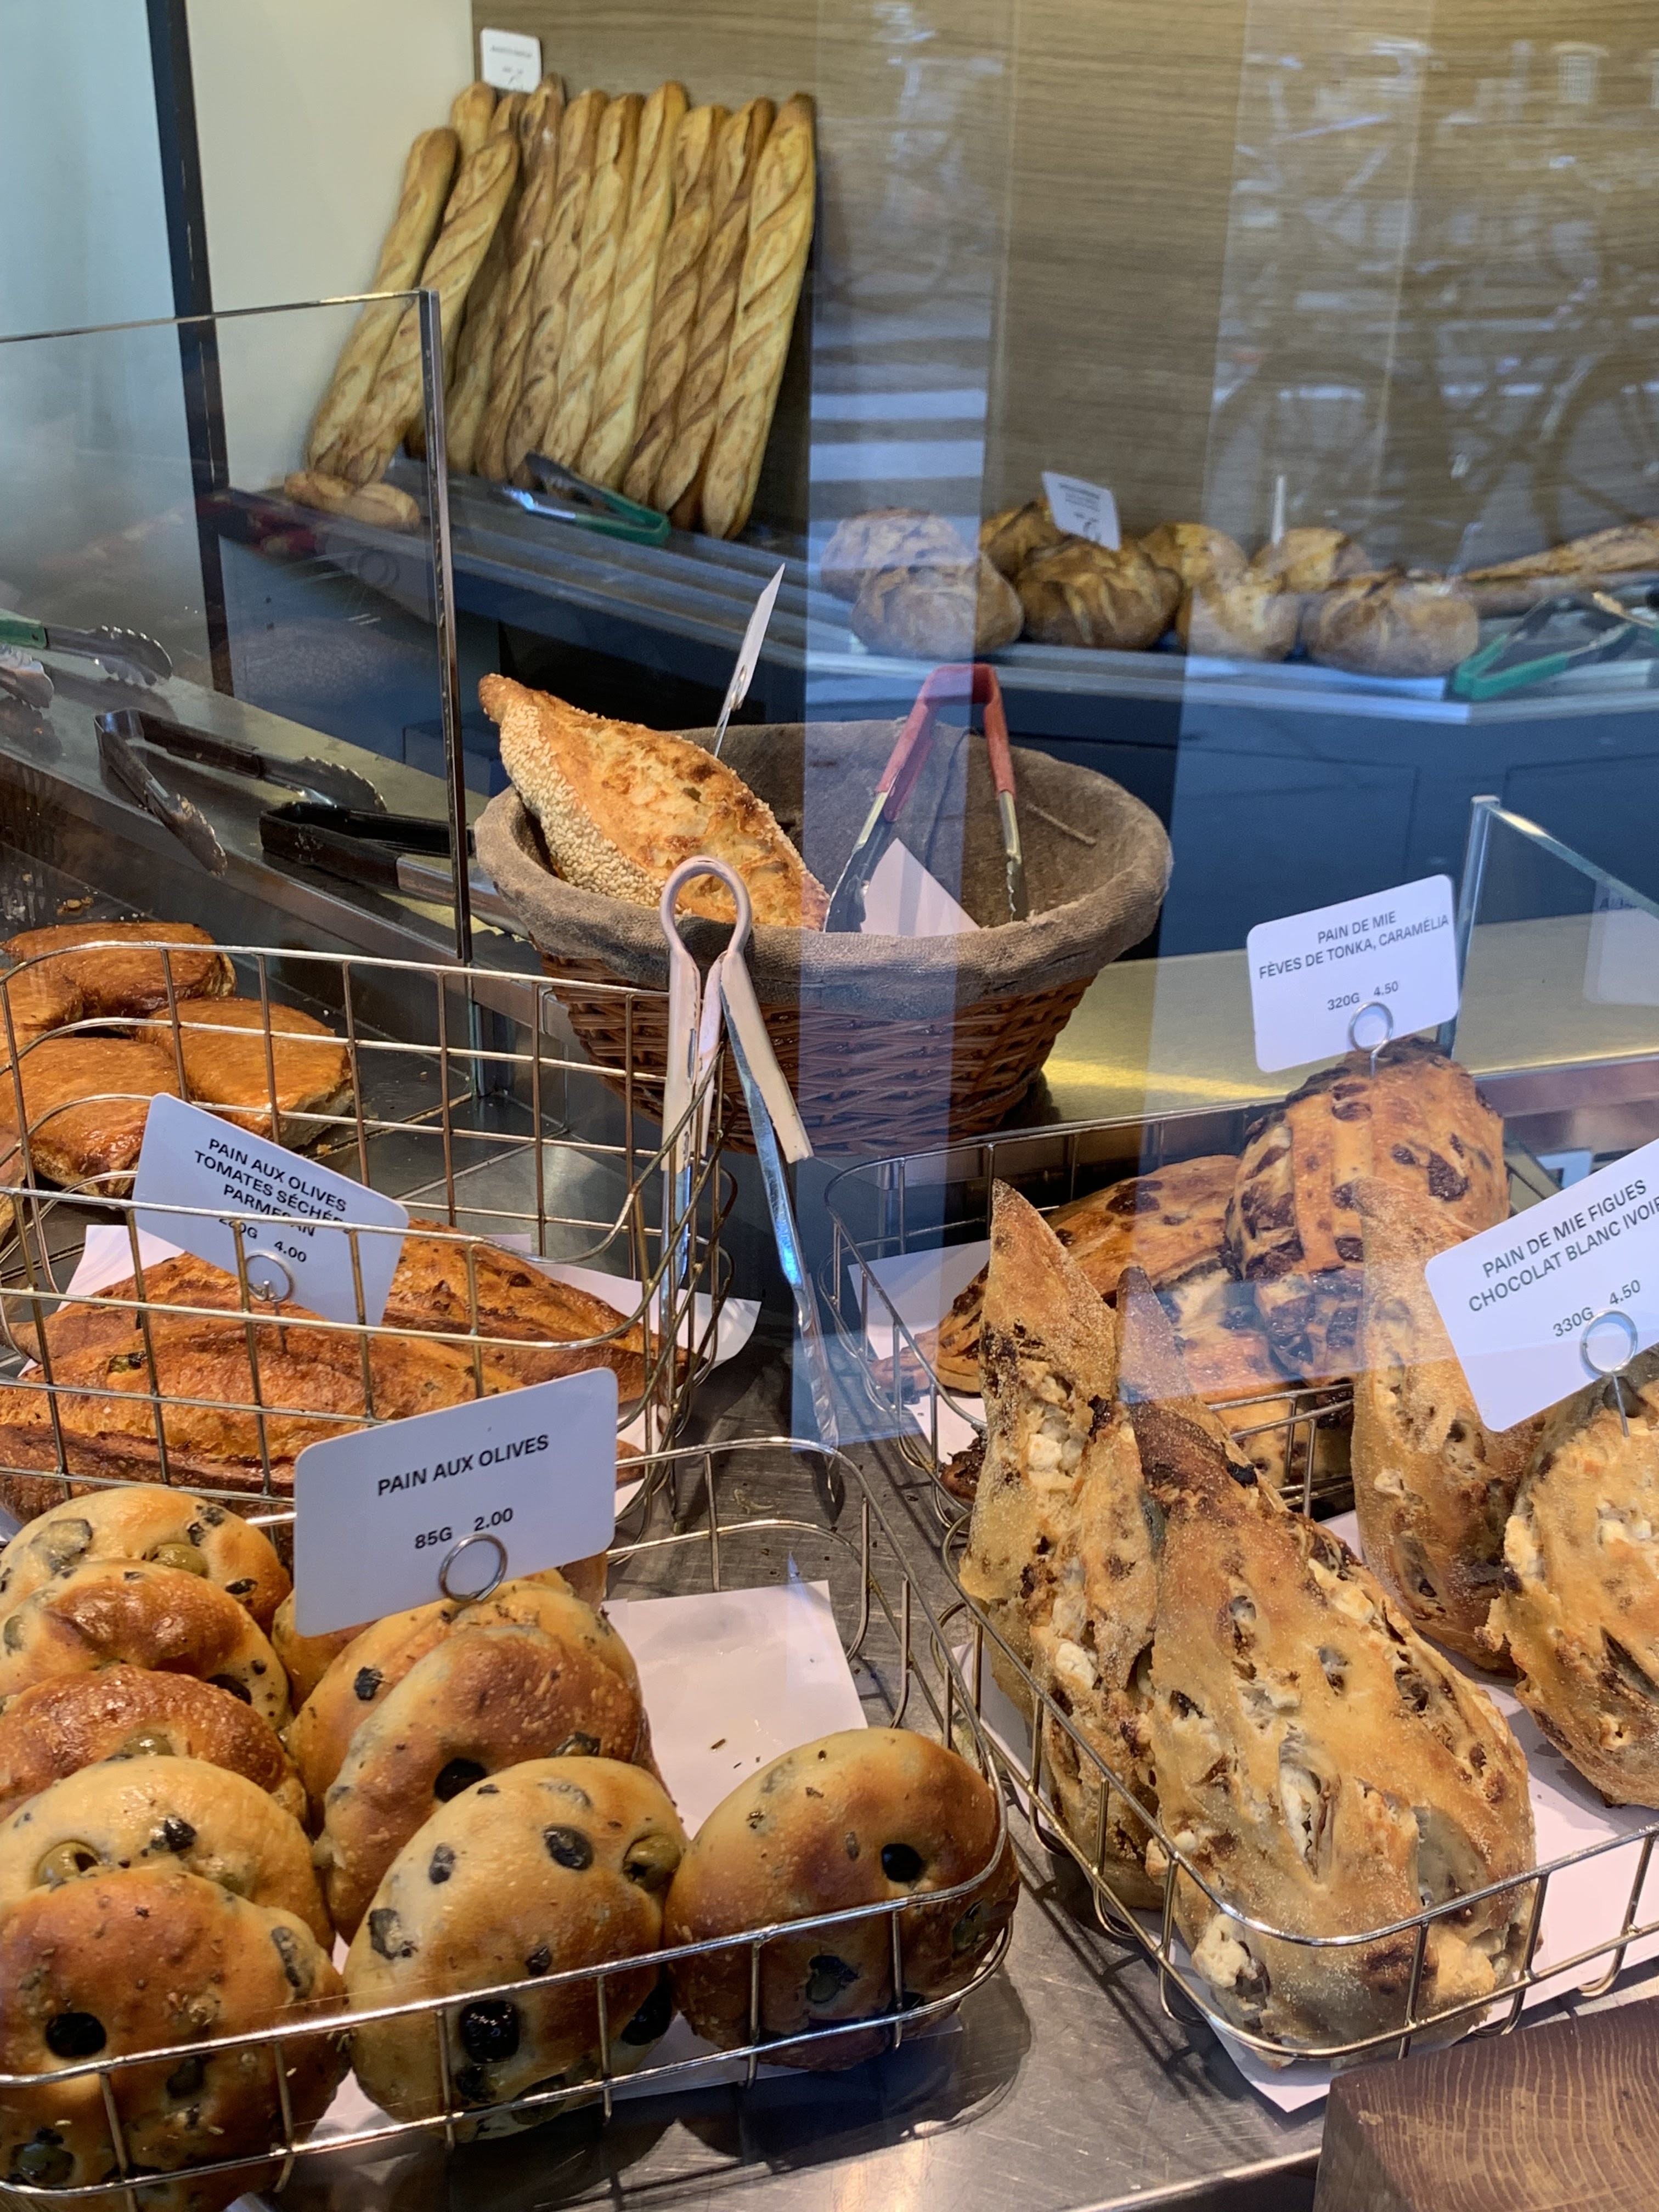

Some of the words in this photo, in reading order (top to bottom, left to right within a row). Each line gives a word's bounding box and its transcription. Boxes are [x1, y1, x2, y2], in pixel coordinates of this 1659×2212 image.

[1259, 957, 1302, 979] FÈVES
[1306, 951, 1323, 967] DE
[1327, 939, 1376, 962] TONKA,
[1379, 915, 1449, 946] CARAMÉLIA
[1318, 926, 1348, 944] PAIN
[1352, 919, 1368, 934] DE
[1373, 911, 1396, 928] MIE
[1328, 993, 1360, 1011] 320G
[1373, 981, 1398, 997] 4.50
[194, 1150, 273, 1197] TOMATES
[276, 1190, 351, 1234] SÉCHÉ
[208, 1138, 247, 1165] PAIN
[251, 1159, 285, 1183] AUX
[289, 1176, 347, 1212] OLIVES
[274, 1241, 307, 1262] 4.00
[1482, 1246, 1525, 1278] PAIN
[1527, 1231, 1552, 1256] DE
[1553, 1213, 1587, 1240] MIE
[1588, 1180, 1646, 1222] FIGUES
[1469, 1252, 1563, 1312] CHOCOLAT
[1565, 1221, 1621, 1261] BLANC
[1553, 1307, 1594, 1337] 330G
[1609, 1279, 1640, 1305] 4.50
[378, 1468, 427, 1496] PAIN
[433, 1455, 473, 1481] AUX
[479, 1435, 549, 1466] OLIVES
[415, 1527, 453, 1549] 85G
[474, 1508, 514, 1531] 2.00
